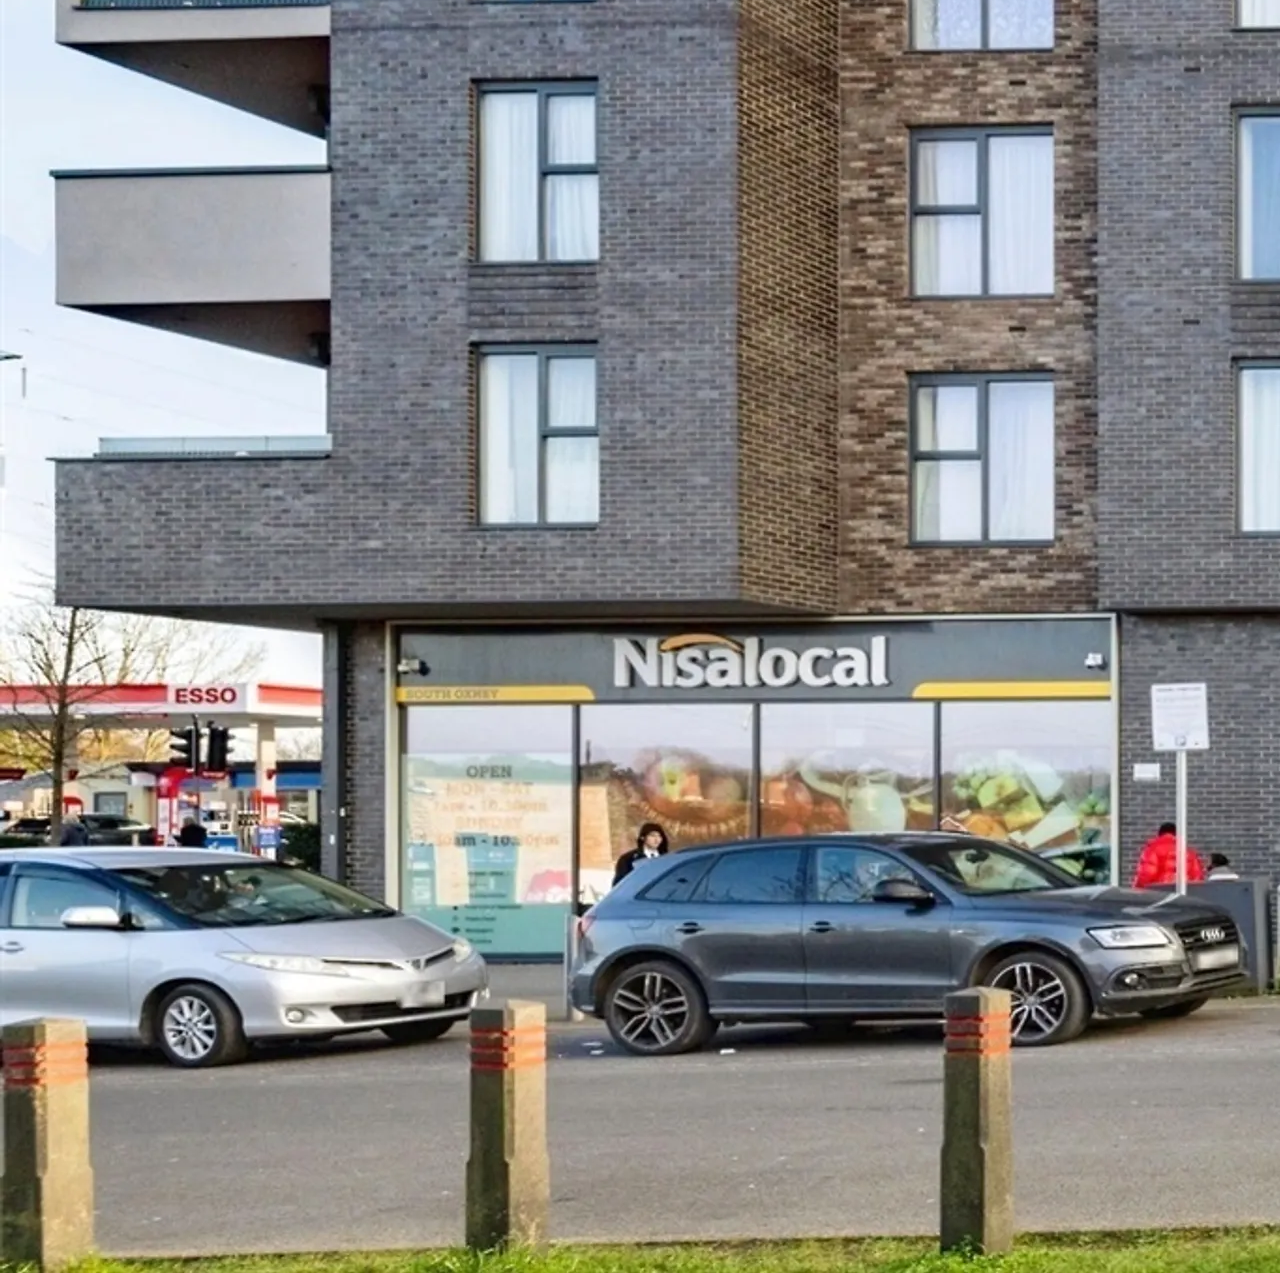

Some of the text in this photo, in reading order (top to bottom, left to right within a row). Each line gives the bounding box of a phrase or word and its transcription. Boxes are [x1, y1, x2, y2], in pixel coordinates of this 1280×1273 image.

[613, 633, 890, 688] Nisalocal
[174, 687, 237, 704] ESSO
[405, 689, 450, 700] SOUTH
[465, 764, 513, 778] OPEN
[445, 782, 485, 795] MON
